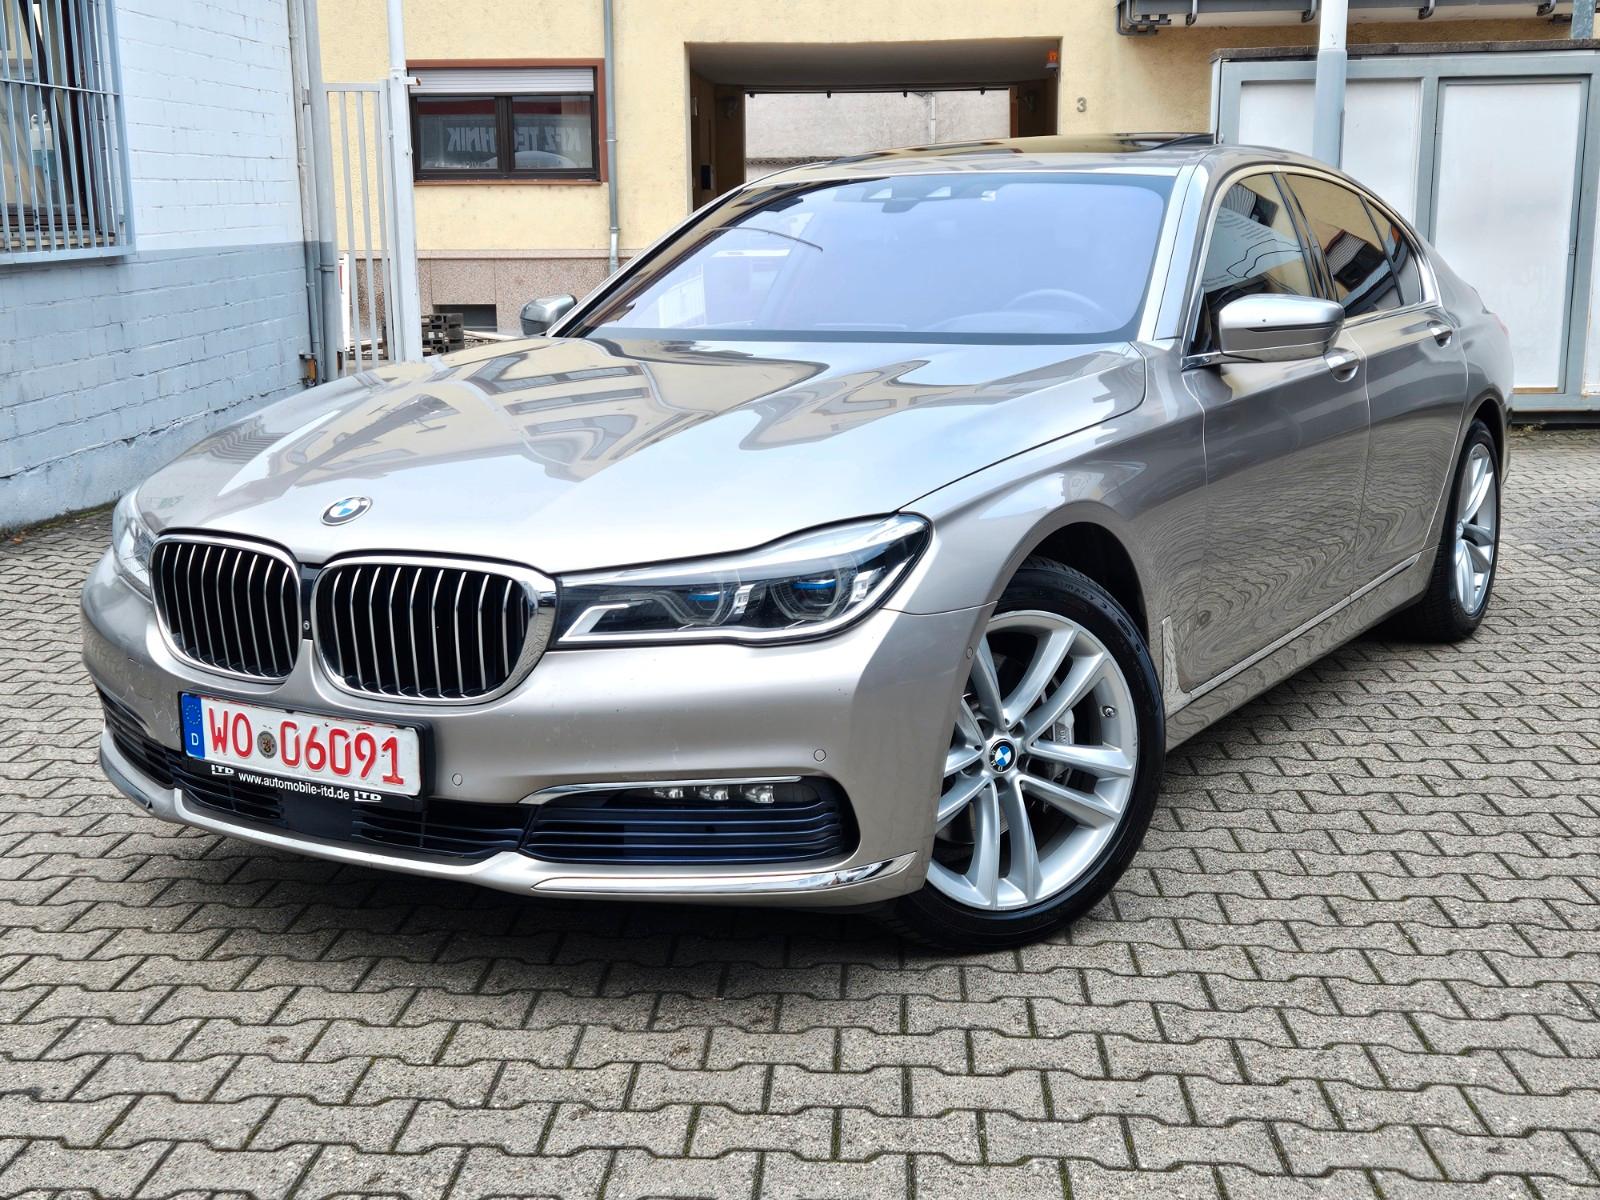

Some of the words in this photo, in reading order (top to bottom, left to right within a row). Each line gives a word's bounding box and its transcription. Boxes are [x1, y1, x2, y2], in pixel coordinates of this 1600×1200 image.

[1076, 96, 1088, 113] 3
[191, 732, 199, 746] D
[208, 707, 253, 759] WO
[279, 720, 405, 785] 06091
[238, 772, 350, 800] www.automobile-itd.de
